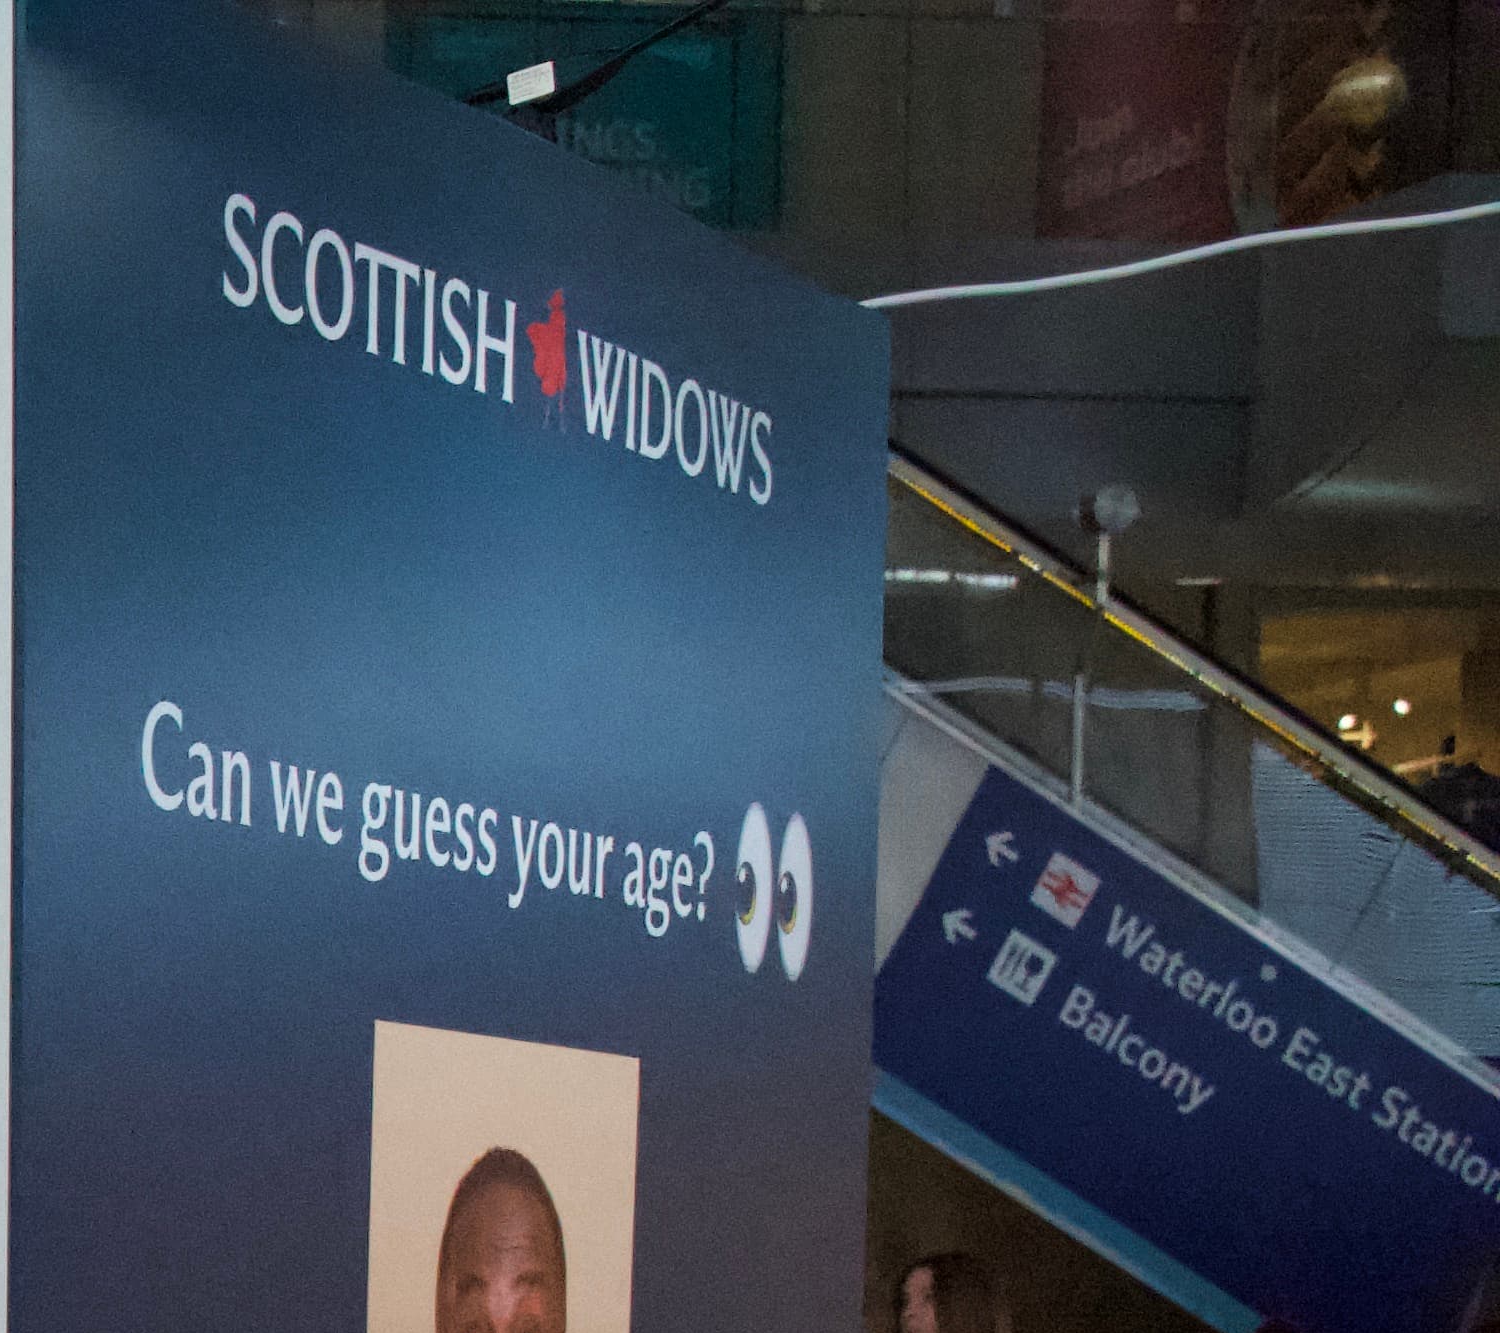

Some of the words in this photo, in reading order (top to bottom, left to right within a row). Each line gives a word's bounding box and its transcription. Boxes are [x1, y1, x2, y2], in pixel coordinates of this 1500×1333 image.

[222, 193, 517, 404] SCOTTISH
[577, 328, 774, 507] WIDOWS
[141, 700, 252, 827] Can
[269, 757, 344, 846] we
[359, 780, 498, 883] guess
[507, 811, 615, 910] your
[623, 829, 715, 937] age?
[1057, 983, 1218, 1118] Balcony
[1104, 904, 1280, 1052] Waterloo
[1281, 1027, 1371, 1112] East
